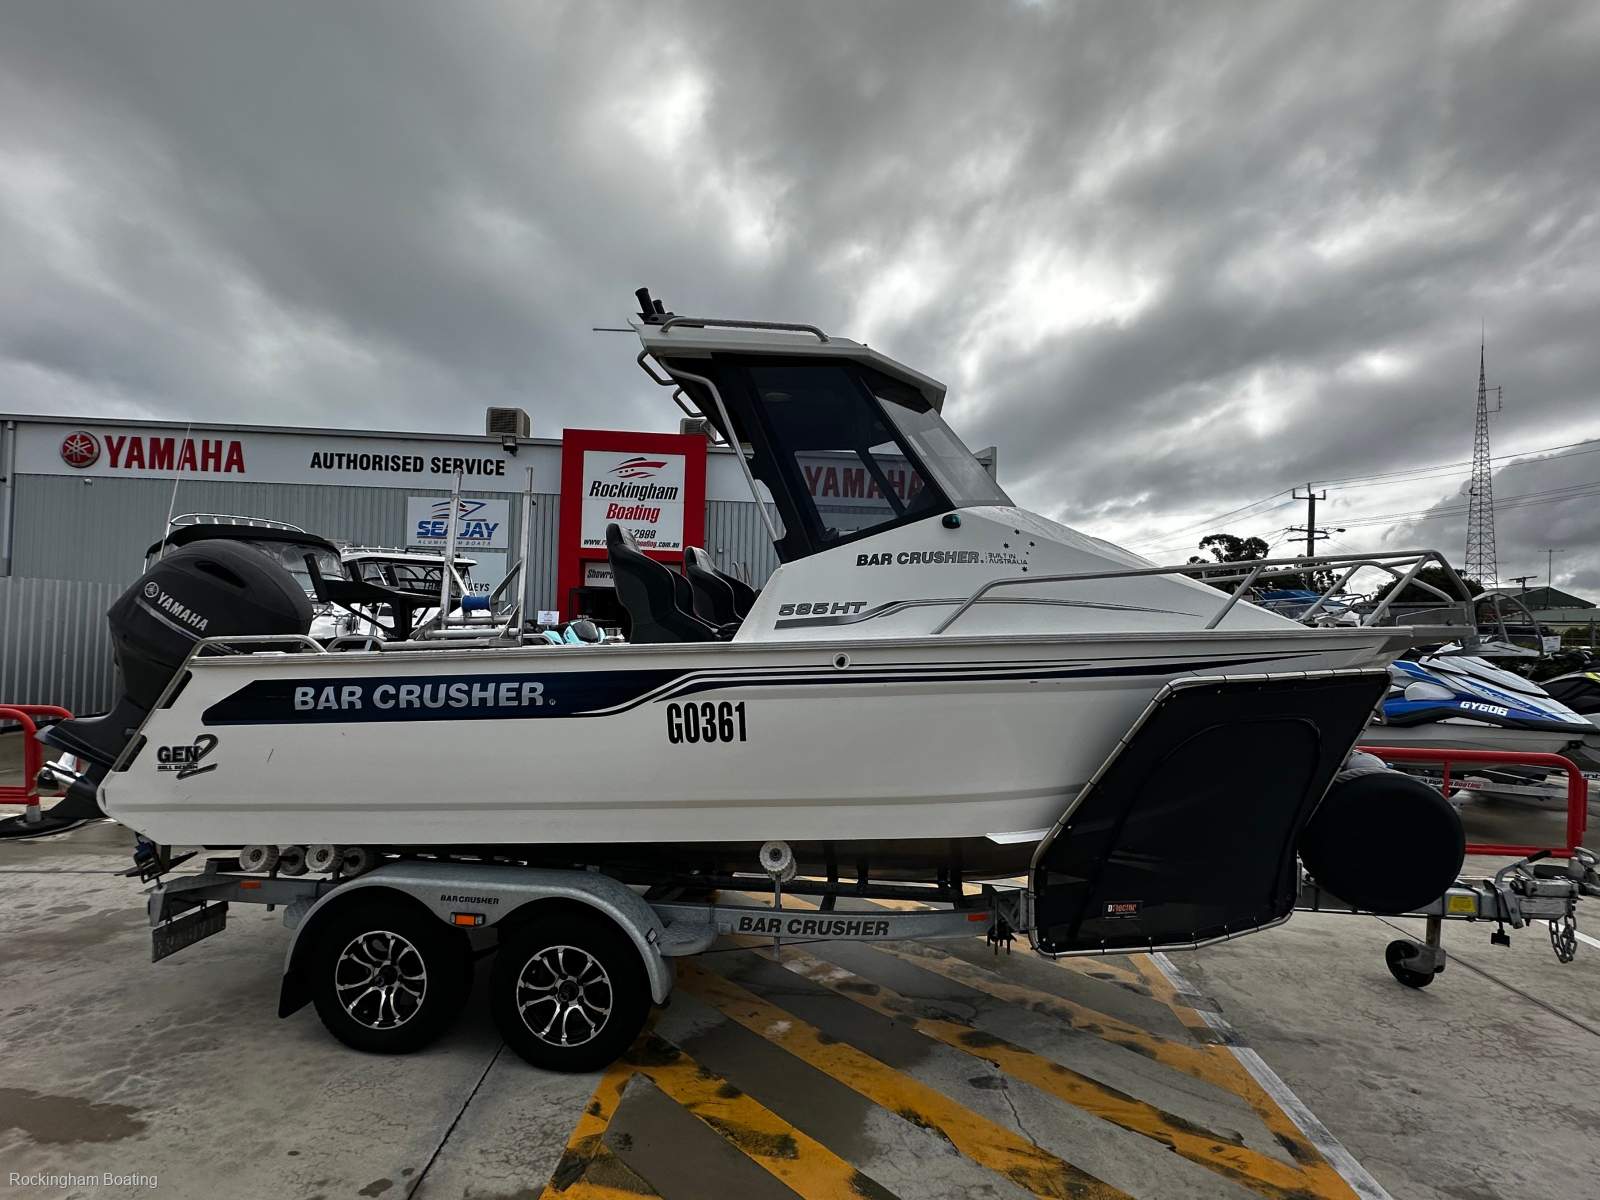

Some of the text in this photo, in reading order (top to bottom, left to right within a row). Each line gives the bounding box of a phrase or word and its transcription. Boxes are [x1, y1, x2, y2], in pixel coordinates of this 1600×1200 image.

[104, 435, 246, 473] YAMAHA
[310, 452, 505, 476] AUTHORISED SERVICE
[589, 480, 678, 501] Rockingham
[606, 503, 660, 523] Boating
[460, 522, 499, 537] JAY
[856, 551, 979, 567] BAR CRUSHER
[158, 592, 208, 631] YAMAHA
[294, 682, 545, 711] BAR CRUSHER
[1460, 701, 1509, 716] GY606
[157, 746, 202, 763] GEN
[738, 917, 890, 936] BAR CRUSHER
